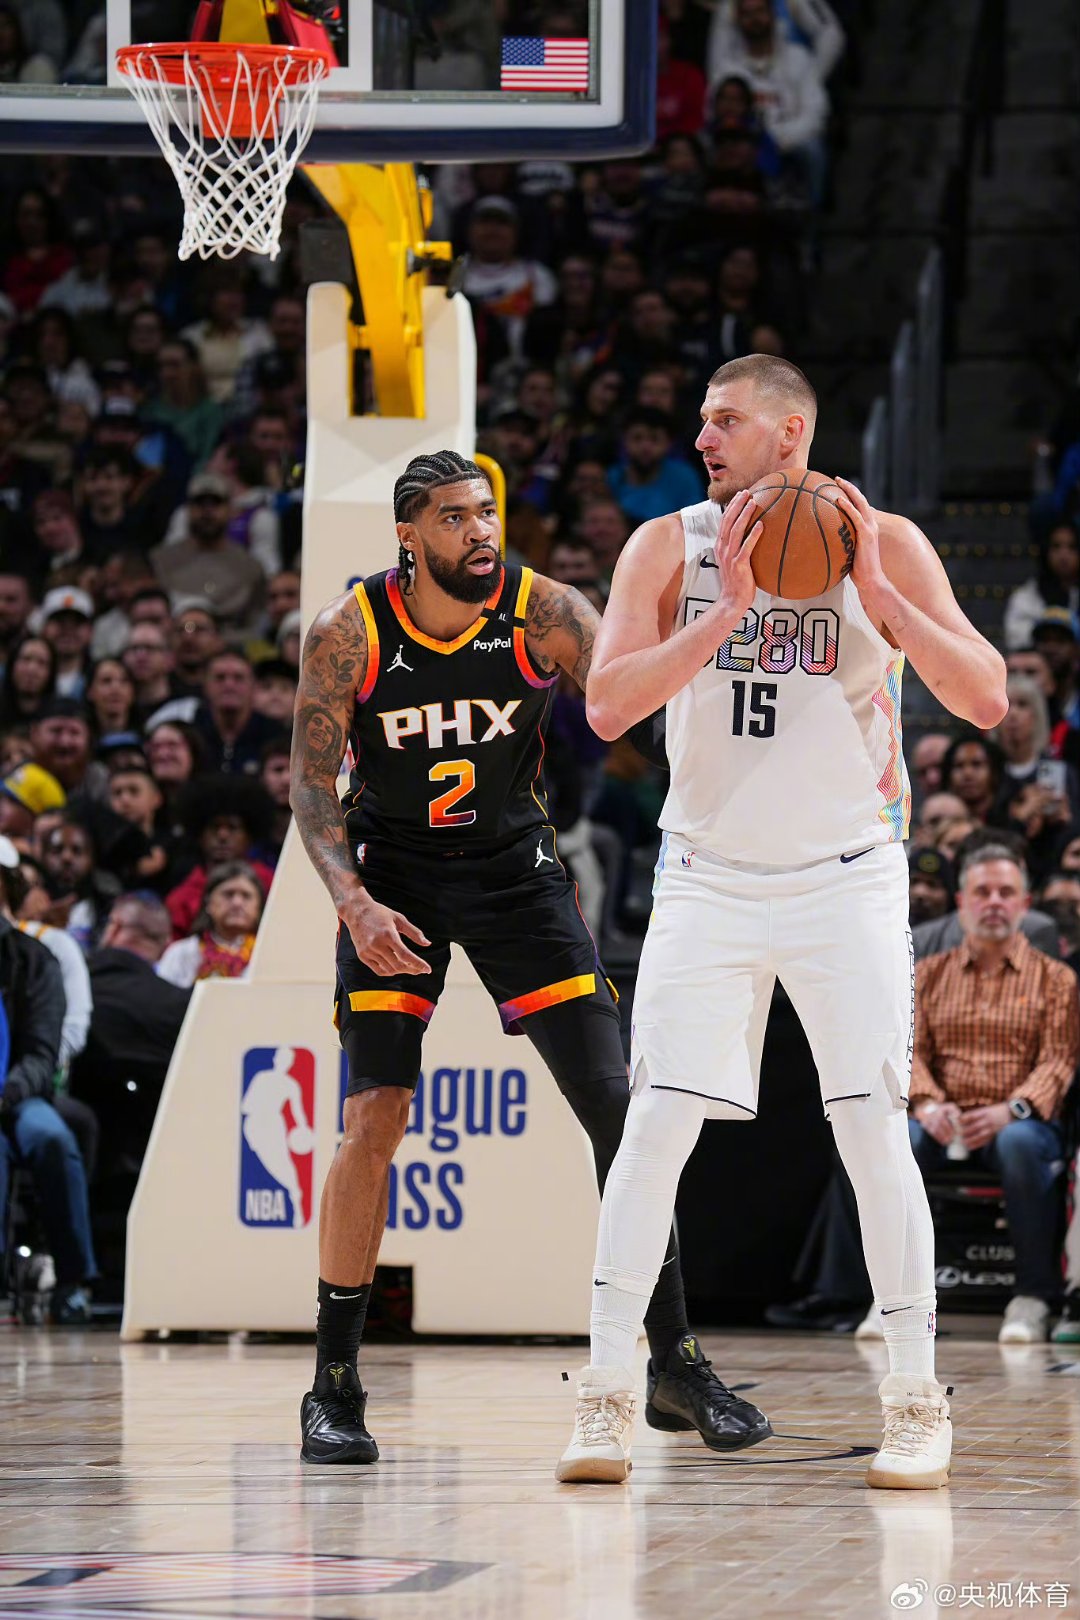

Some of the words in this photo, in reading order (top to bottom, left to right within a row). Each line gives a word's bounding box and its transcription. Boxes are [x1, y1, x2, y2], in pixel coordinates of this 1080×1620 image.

[473, 638, 511, 652] PayPal
[684, 597, 840, 675] 280
[376, 699, 522, 749] PHX
[731, 680, 777, 738] 15
[429, 758, 476, 828] 2
[246, 1190, 286, 1222] NBA
